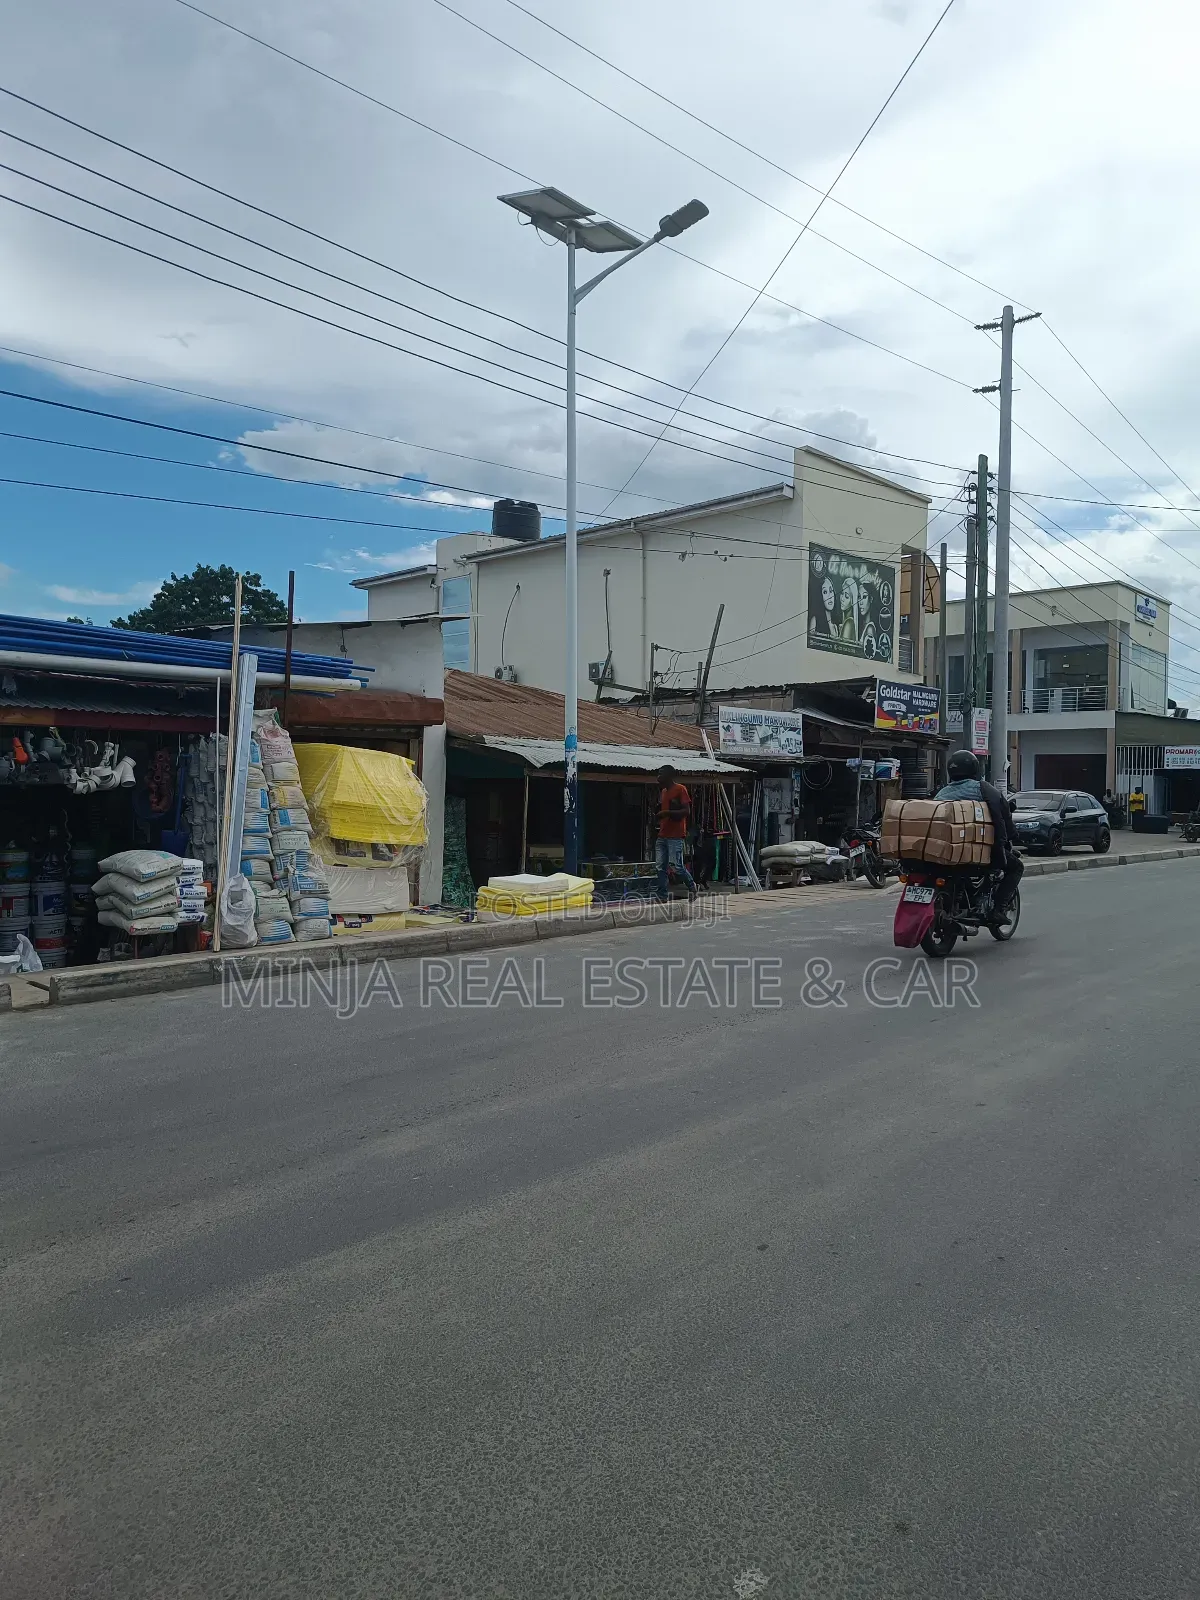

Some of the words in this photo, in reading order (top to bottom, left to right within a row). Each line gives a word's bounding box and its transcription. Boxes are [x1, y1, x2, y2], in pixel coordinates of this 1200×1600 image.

[880, 684, 911, 701] Goldstar
[912, 698, 937, 708] HARDWARE
[764, 714, 800, 728] HARDWARE
